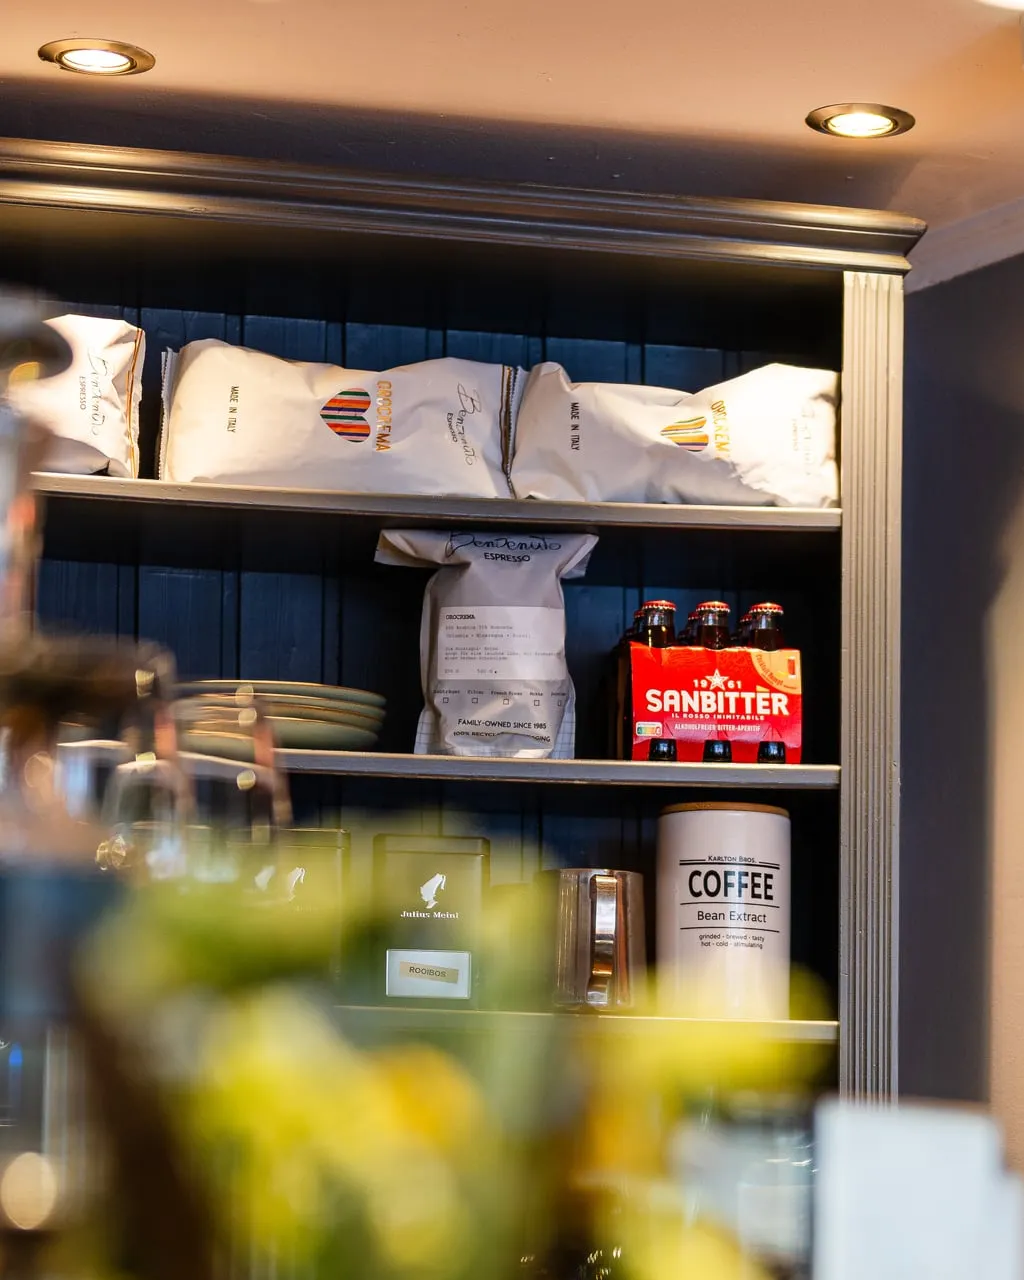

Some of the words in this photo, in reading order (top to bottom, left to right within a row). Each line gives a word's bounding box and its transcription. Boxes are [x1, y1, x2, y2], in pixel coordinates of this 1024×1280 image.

[230, 385, 239, 403] MADE
[570, 402, 580, 420] MADE
[227, 417, 236, 433] ITALY
[570, 434, 580, 451] ITALY
[484, 552, 530, 562] ESPRESSO
[458, 719, 511, 729] FAMILY-OWNED
[688, 869, 774, 901] COFFEE
[433, 911, 459, 919] Meinl
[697, 910, 725, 921] Bean
[729, 911, 767, 923] Extract
[698, 933, 720, 941] grinded
[734, 941, 763, 950] stimulating
